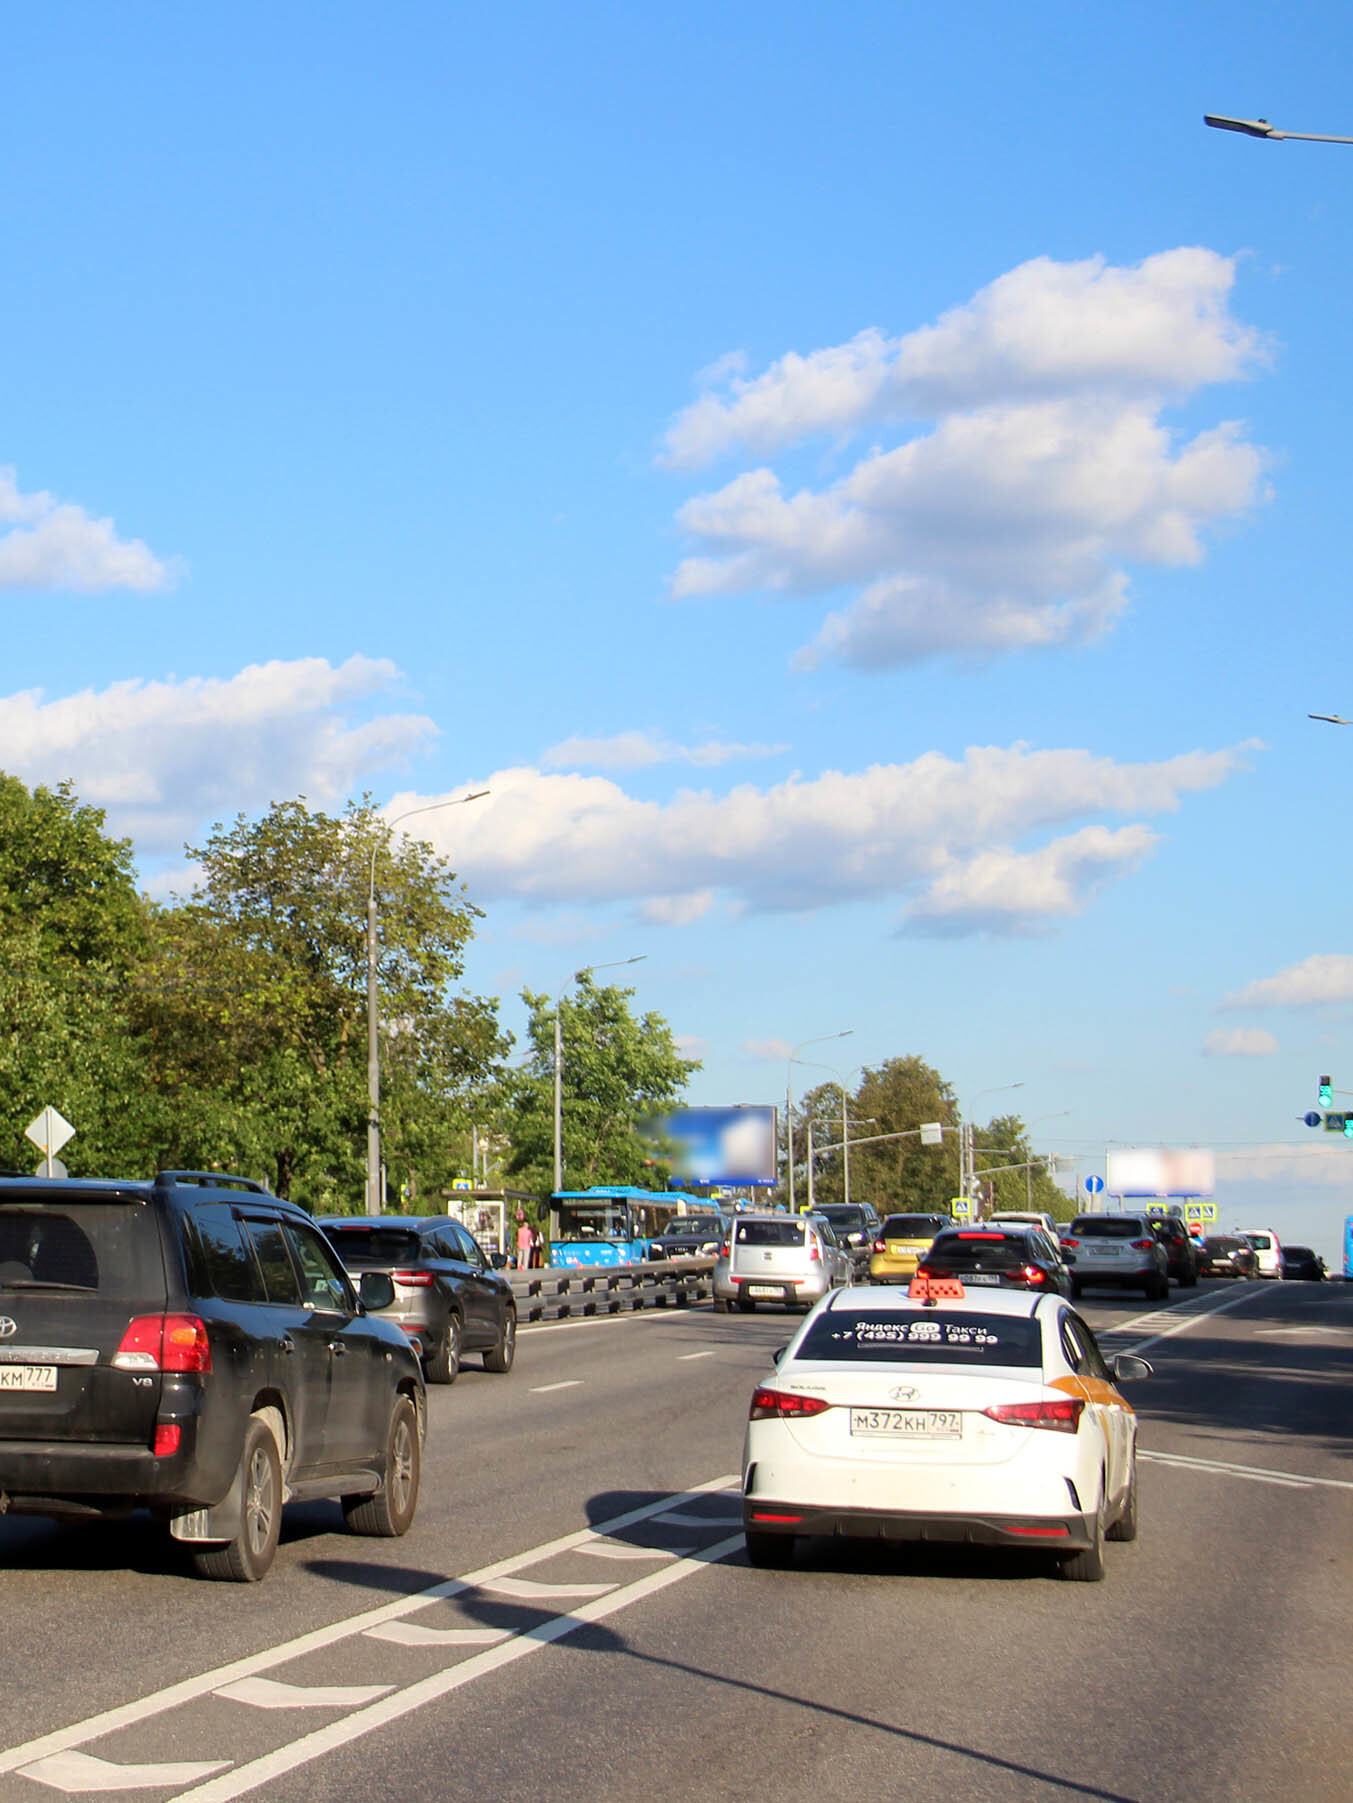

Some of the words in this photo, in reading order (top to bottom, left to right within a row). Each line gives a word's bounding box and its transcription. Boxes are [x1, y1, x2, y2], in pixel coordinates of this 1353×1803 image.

[855, 1321, 908, 1333] Яндекс
[944, 1323, 988, 1336] Такси
[857, 1330, 904, 1342] (495)
[908, 1331, 941, 1343] 999
[948, 1333, 970, 1344] 99
[975, 1334, 998, 1345] 99
